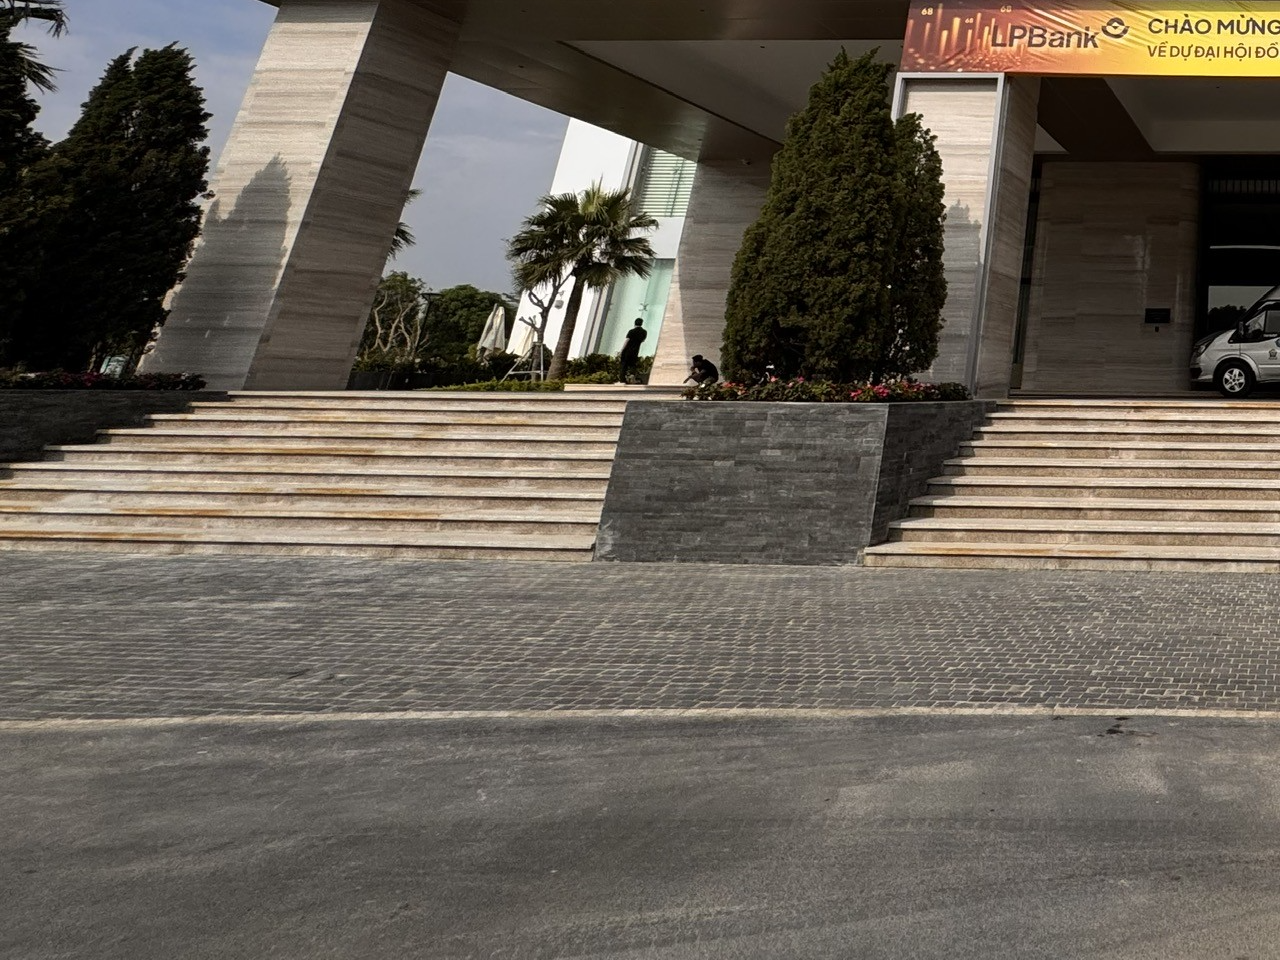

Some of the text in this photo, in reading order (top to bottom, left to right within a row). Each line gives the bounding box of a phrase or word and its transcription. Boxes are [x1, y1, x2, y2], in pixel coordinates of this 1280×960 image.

[921, 8, 934, 16] 68
[1000, 5, 1012, 13] 68
[1148, 14, 1212, 35] CHÀO
[991, 24, 1100, 49] LPBank
[1147, 41, 1168, 58] VỀ
[1170, 44, 1194, 61] DỰ
[1194, 46, 1220, 61] ĐẠI
[1224, 42, 1251, 61] HỘI
